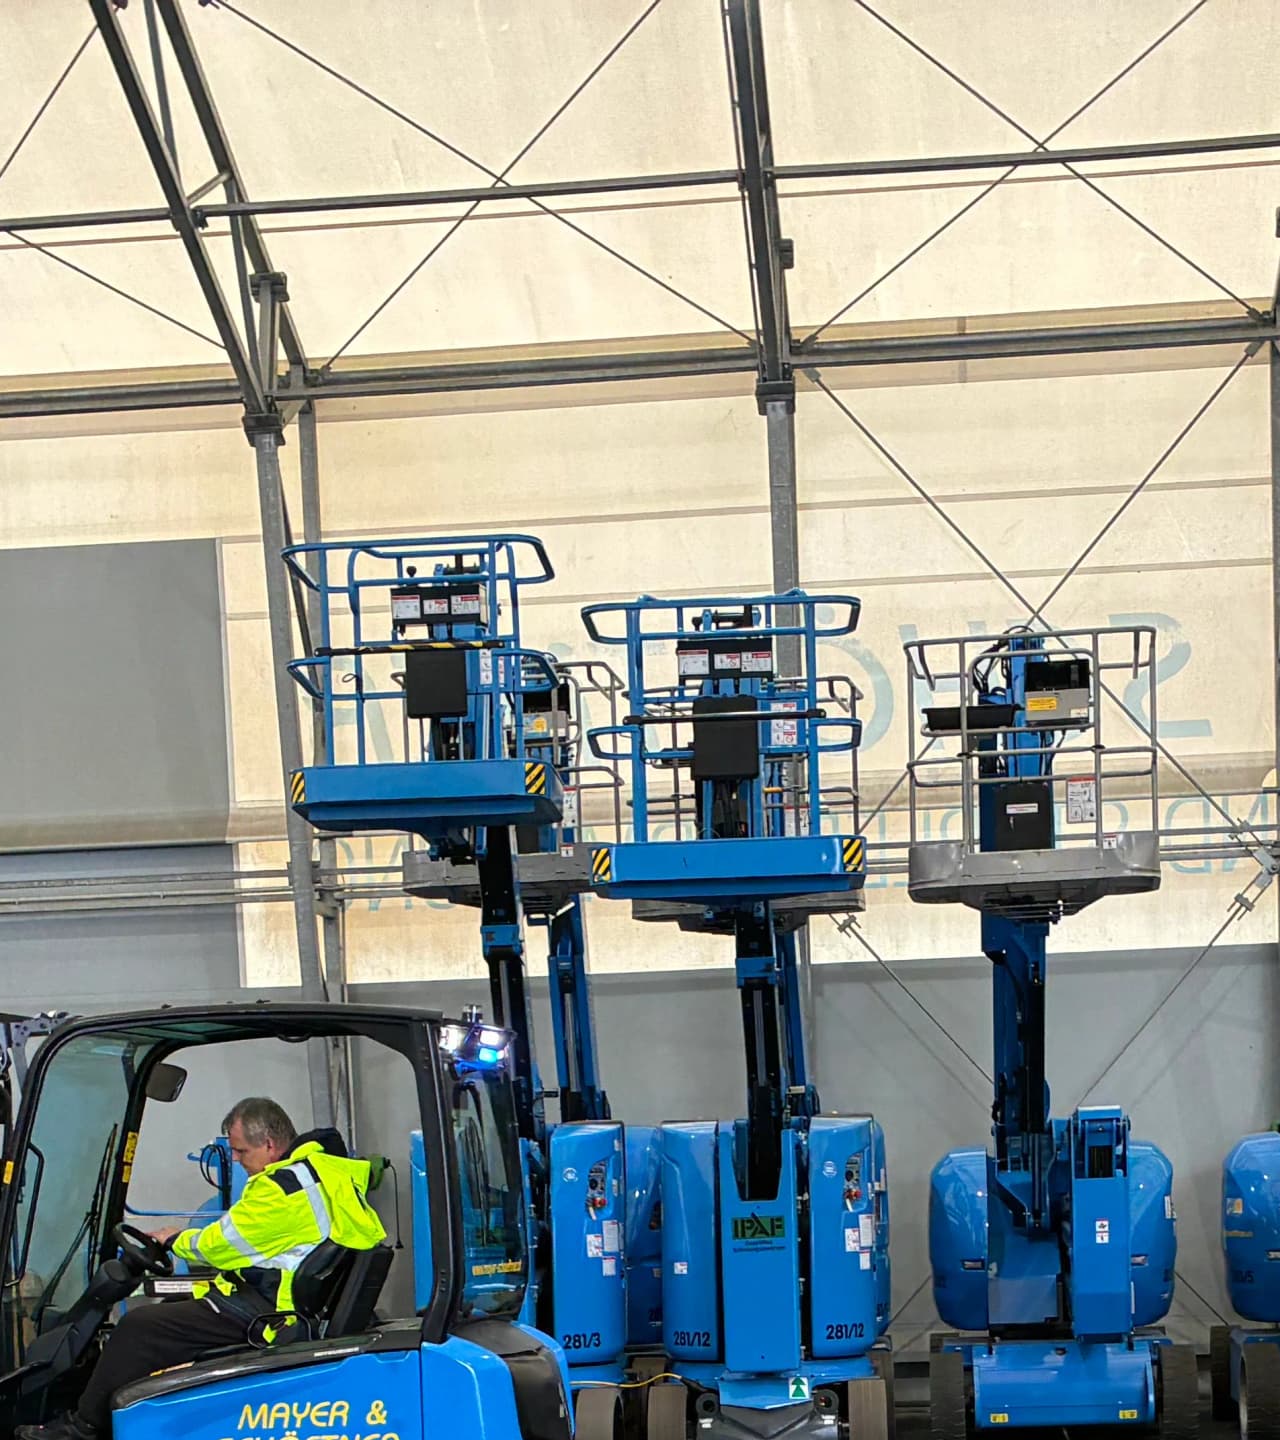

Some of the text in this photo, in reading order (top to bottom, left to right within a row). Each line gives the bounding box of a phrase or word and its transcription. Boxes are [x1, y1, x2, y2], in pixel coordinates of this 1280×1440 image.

[733, 1212, 784, 1239] IPAF
[562, 1332, 602, 1350] 281/3
[672, 1330, 711, 1348] 281/12
[825, 1322, 865, 1341] 281/12
[236, 1399, 388, 1430] MAYER &
